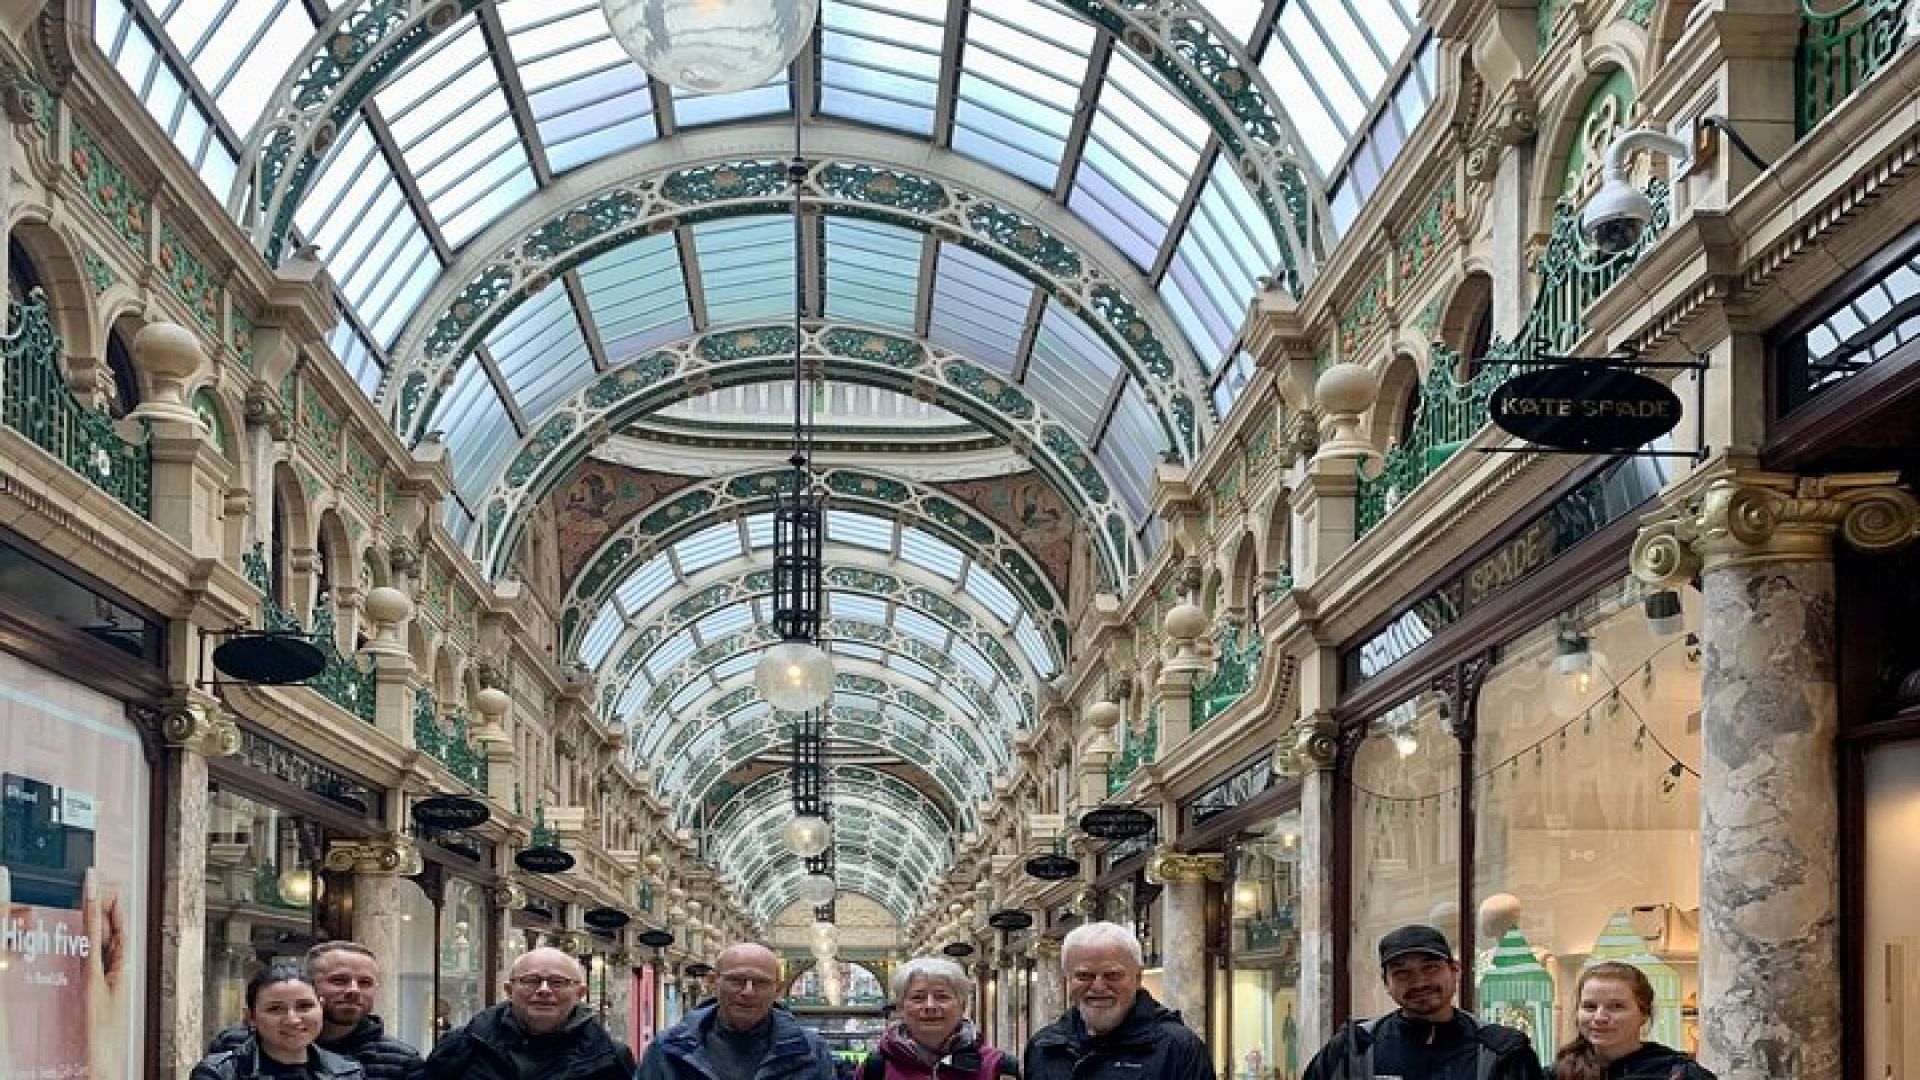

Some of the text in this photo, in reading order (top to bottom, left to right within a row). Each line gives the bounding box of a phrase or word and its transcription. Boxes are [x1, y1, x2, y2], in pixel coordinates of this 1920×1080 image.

[1501, 397, 1670, 417] KATE SPADE
[1471, 526, 1541, 605] SPADE
[2, 917, 90, 962] High five
